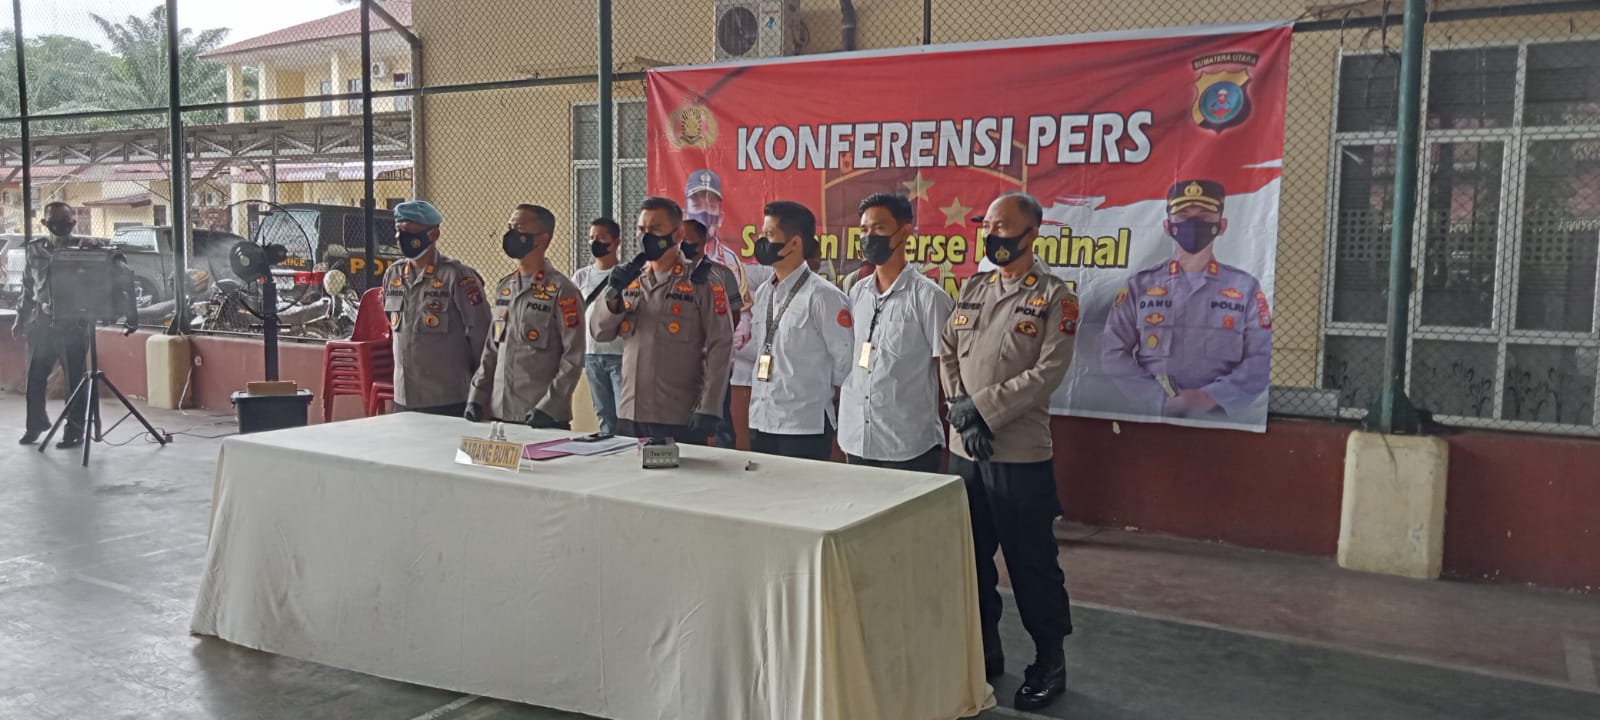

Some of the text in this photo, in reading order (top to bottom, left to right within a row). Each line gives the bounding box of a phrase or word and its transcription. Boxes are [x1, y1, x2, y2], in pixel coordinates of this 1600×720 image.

[736, 110, 1154, 171] KONFERENSI PERS
[665, 293, 694, 302] POLRI
[526, 301, 552, 313] POLRI
[1210, 302, 1245, 312] POLRI
[493, 443, 520, 466] BUKTI
